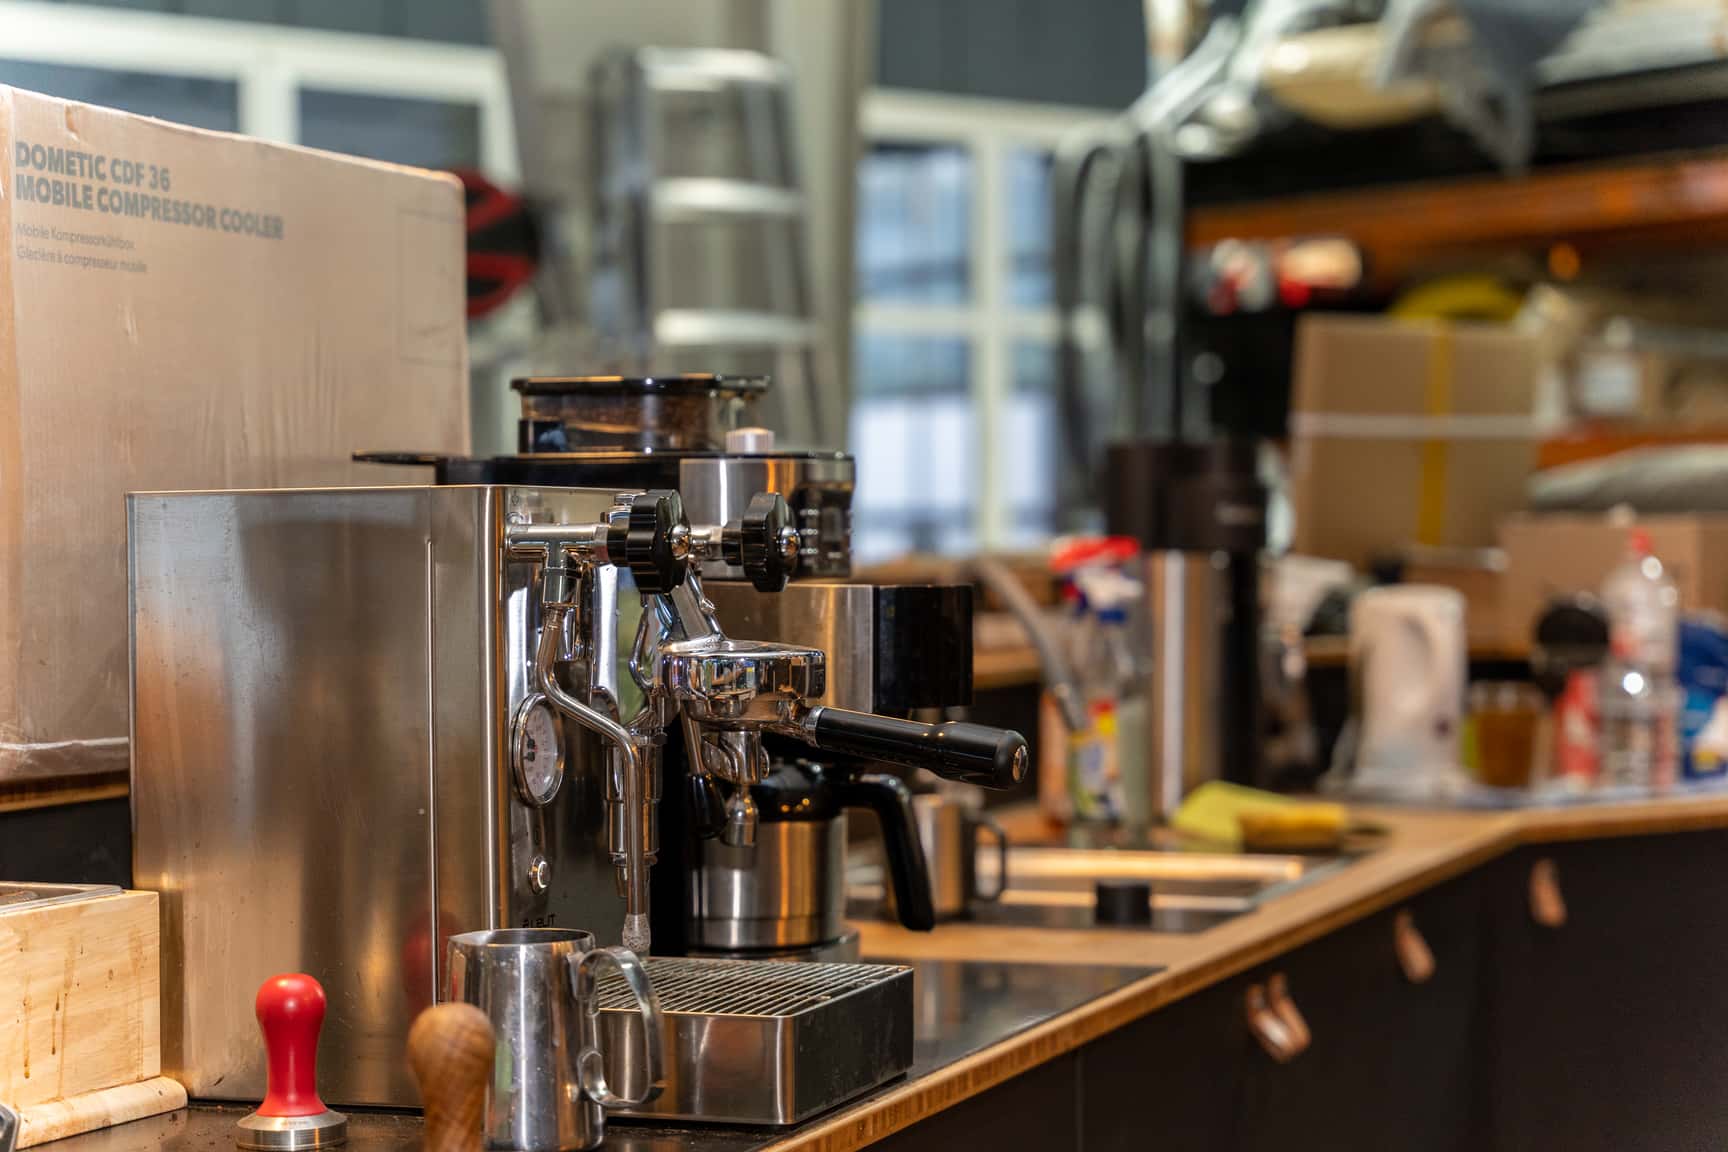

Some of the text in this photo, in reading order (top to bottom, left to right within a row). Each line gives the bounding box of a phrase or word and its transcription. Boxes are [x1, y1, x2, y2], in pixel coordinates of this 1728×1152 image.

[15, 141, 171, 192] DOMETIC CDF 36
[15, 174, 284, 241] MOBILE COMPRESSOR COOLER
[15, 223, 49, 239] Mobile
